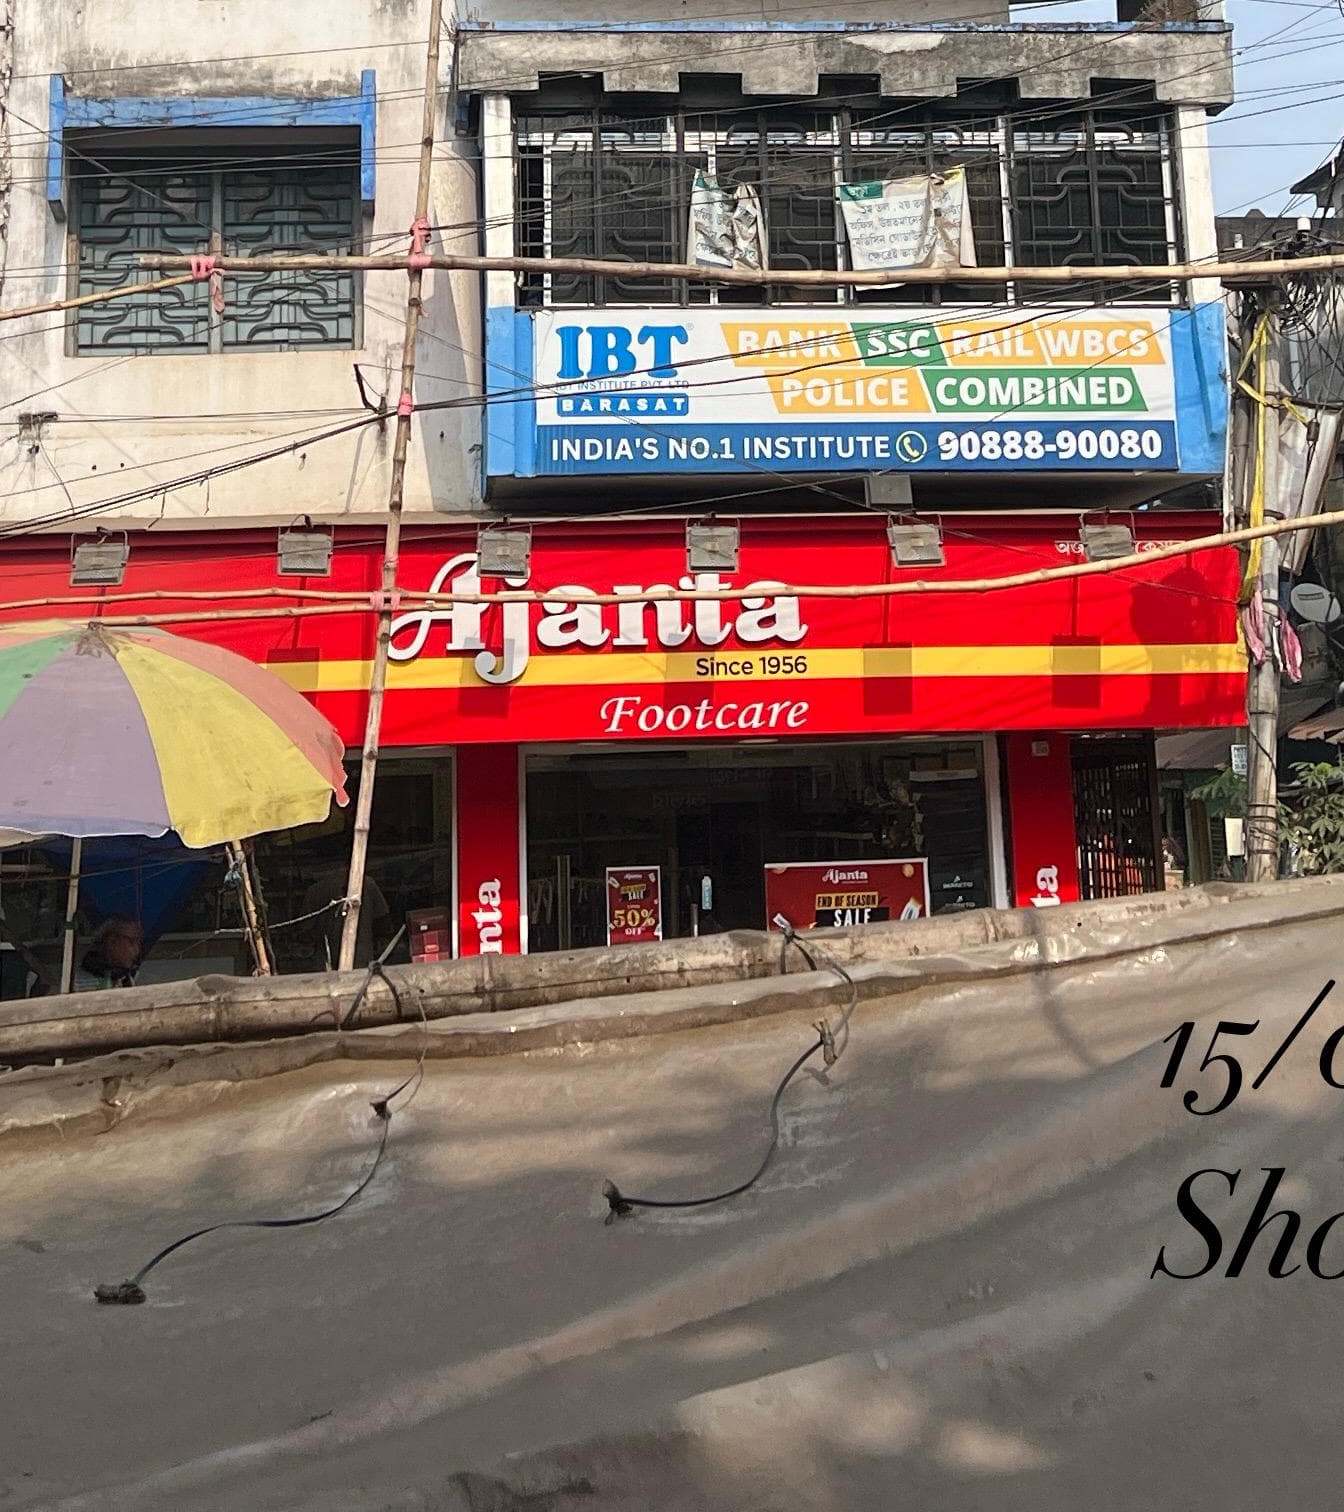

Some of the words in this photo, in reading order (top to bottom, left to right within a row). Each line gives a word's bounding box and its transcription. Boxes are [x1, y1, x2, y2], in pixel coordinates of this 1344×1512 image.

[556, 325, 689, 379] IBT
[737, 329, 842, 357] BANK
[866, 328, 932, 359] SSC
[954, 329, 1034, 357] RAIL
[1043, 328, 1150, 357] WBCS
[561, 398, 686, 412] BARASAT
[782, 378, 909, 407] POLICE
[935, 376, 1134, 406] COMBINED
[552, 438, 659, 461] INDIA'S
[669, 438, 735, 460] NO.1
[744, 436, 890, 459] INSTITUTE
[937, 429, 1163, 461] 90888-90080
[385, 553, 809, 685] Ajanta
[696, 658, 754, 676] Since
[759, 657, 809, 675] 1956
[600, 696, 809, 733] Footcare
[822, 868, 869, 884] Ajanta
[817, 895, 832, 908] END
[834, 894, 845, 907] OF
[847, 893, 877, 907] SEASON
[613, 908, 656, 929] 50%
